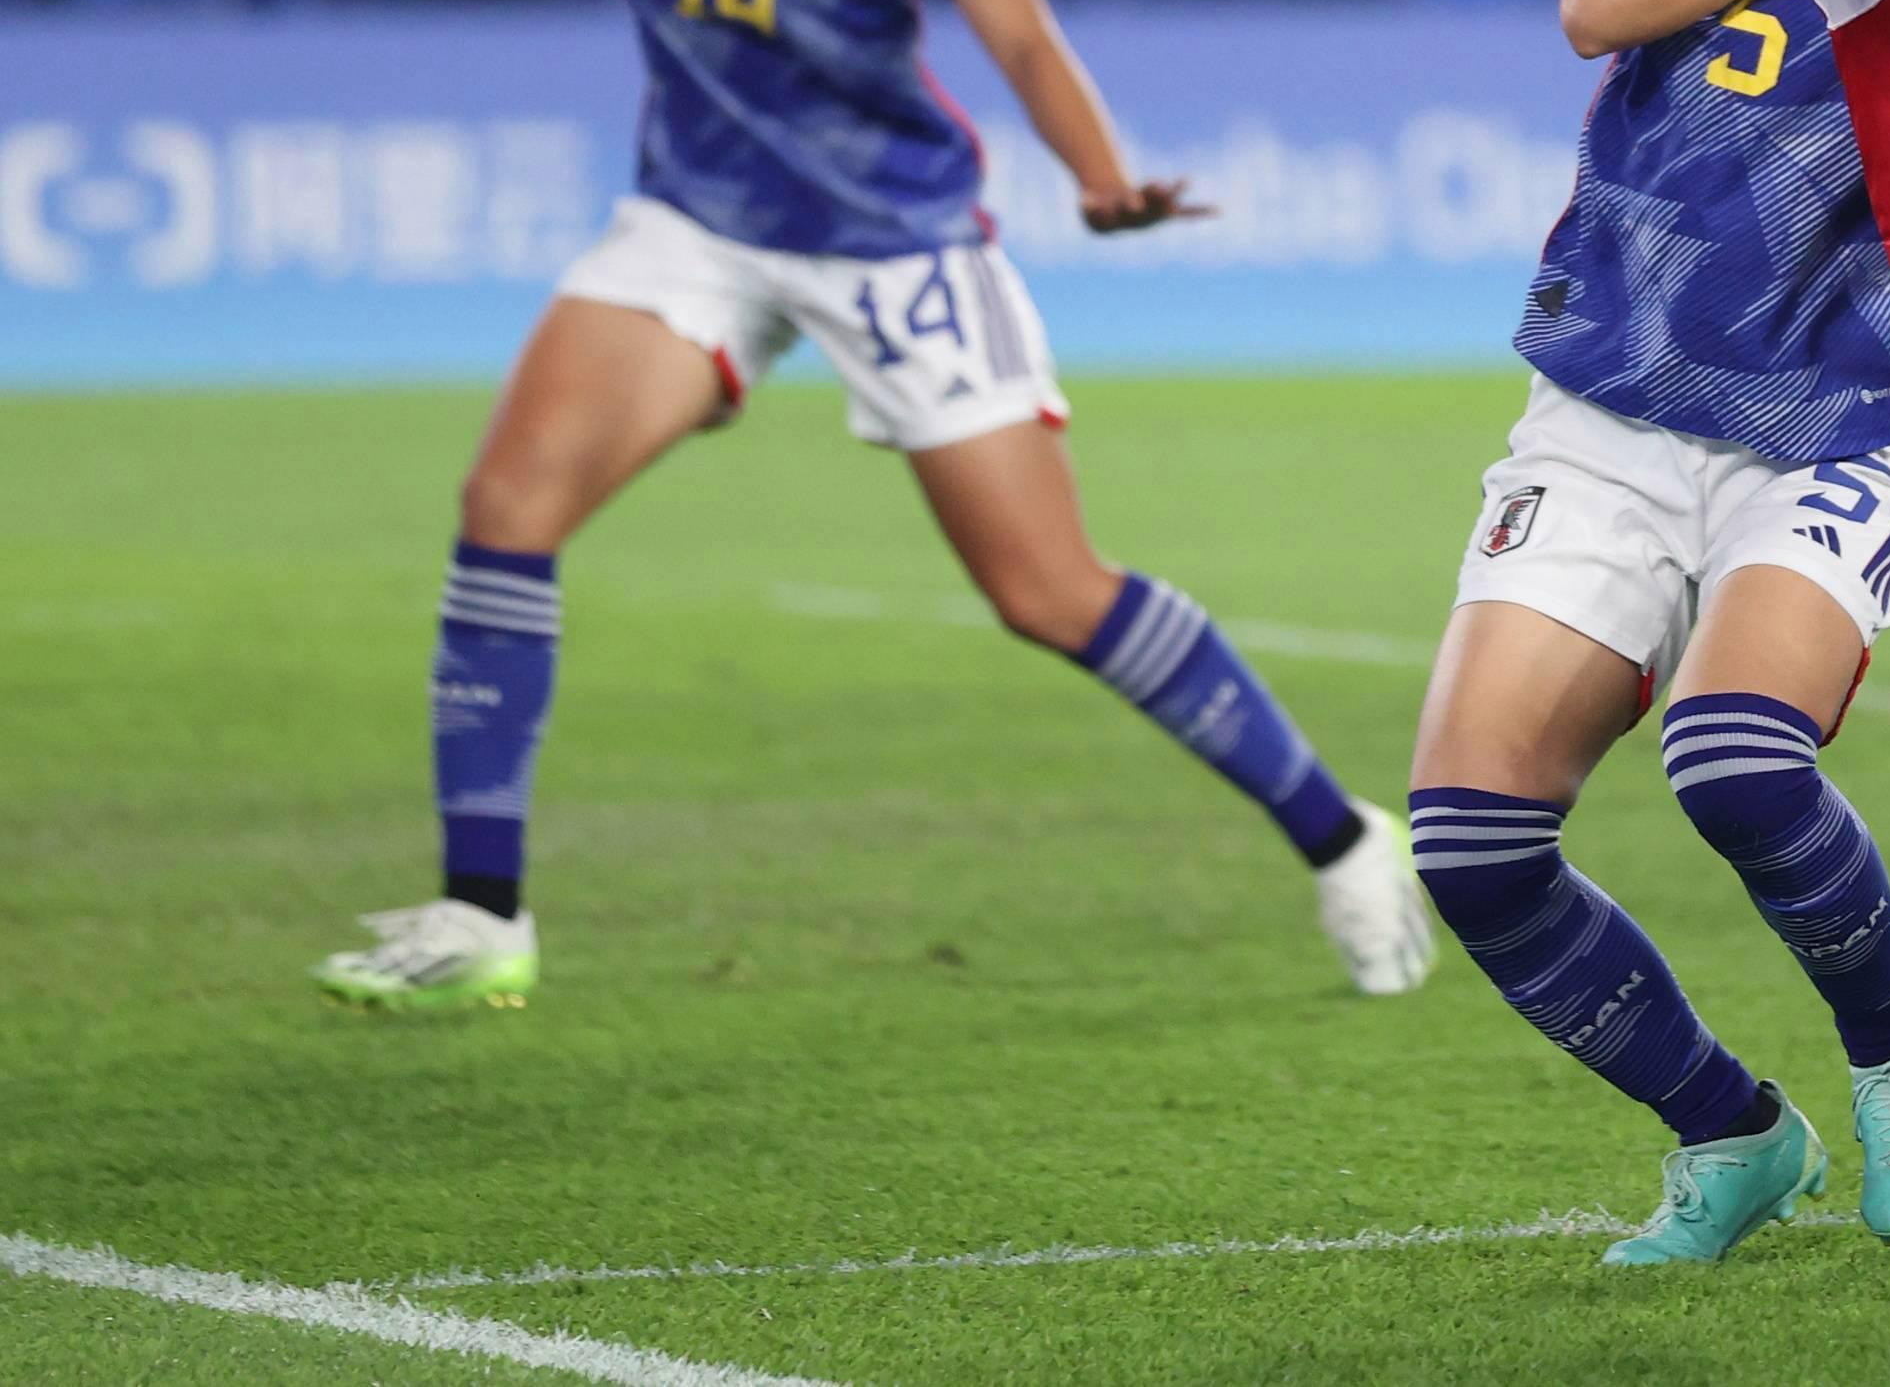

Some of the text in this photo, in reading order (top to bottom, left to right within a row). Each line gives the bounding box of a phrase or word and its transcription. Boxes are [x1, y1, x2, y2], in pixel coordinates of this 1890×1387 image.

[855, 251, 968, 369] 14
[1782, 896, 1888, 958] PAN
[1552, 970, 1646, 1049] PAN
